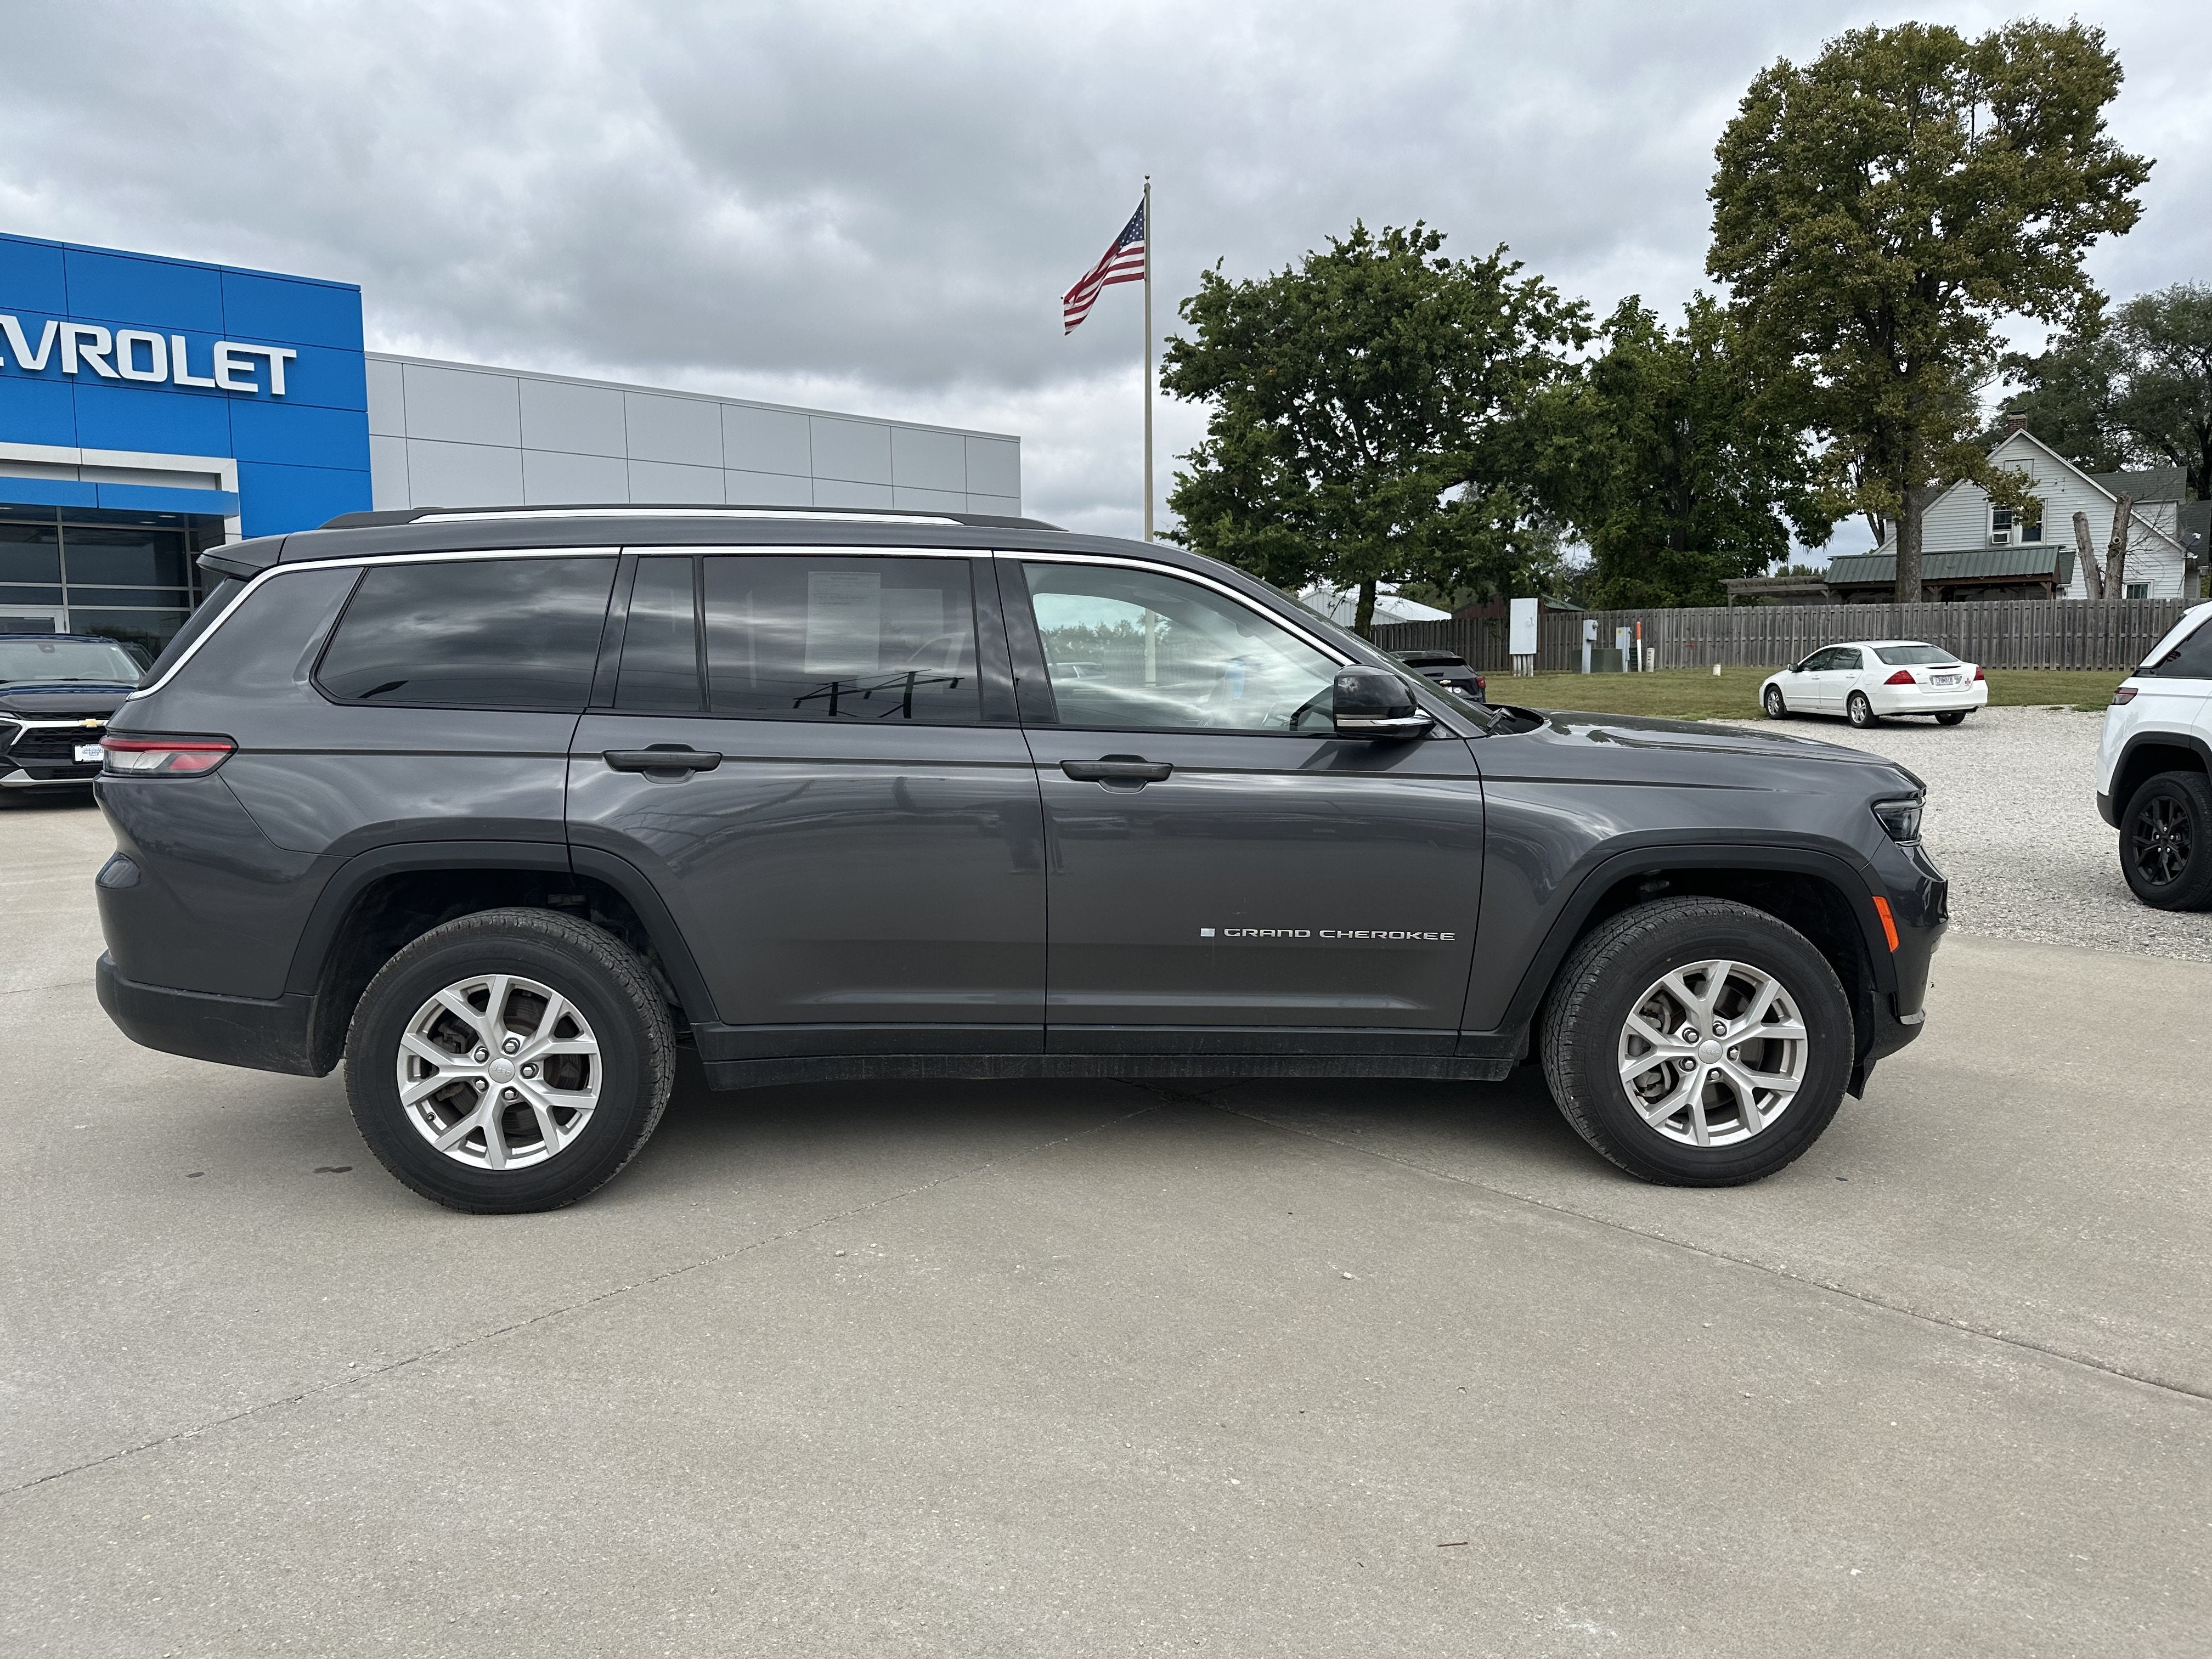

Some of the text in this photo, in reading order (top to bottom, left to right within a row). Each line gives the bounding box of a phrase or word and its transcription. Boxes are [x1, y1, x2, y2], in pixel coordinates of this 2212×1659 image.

[0, 314, 297, 395] VROLET
[1223, 928, 1455, 941] GRAND CHEROKEE
[1701, 1046, 1720, 1058] Jeep
[492, 1064, 512, 1077] Jeep
